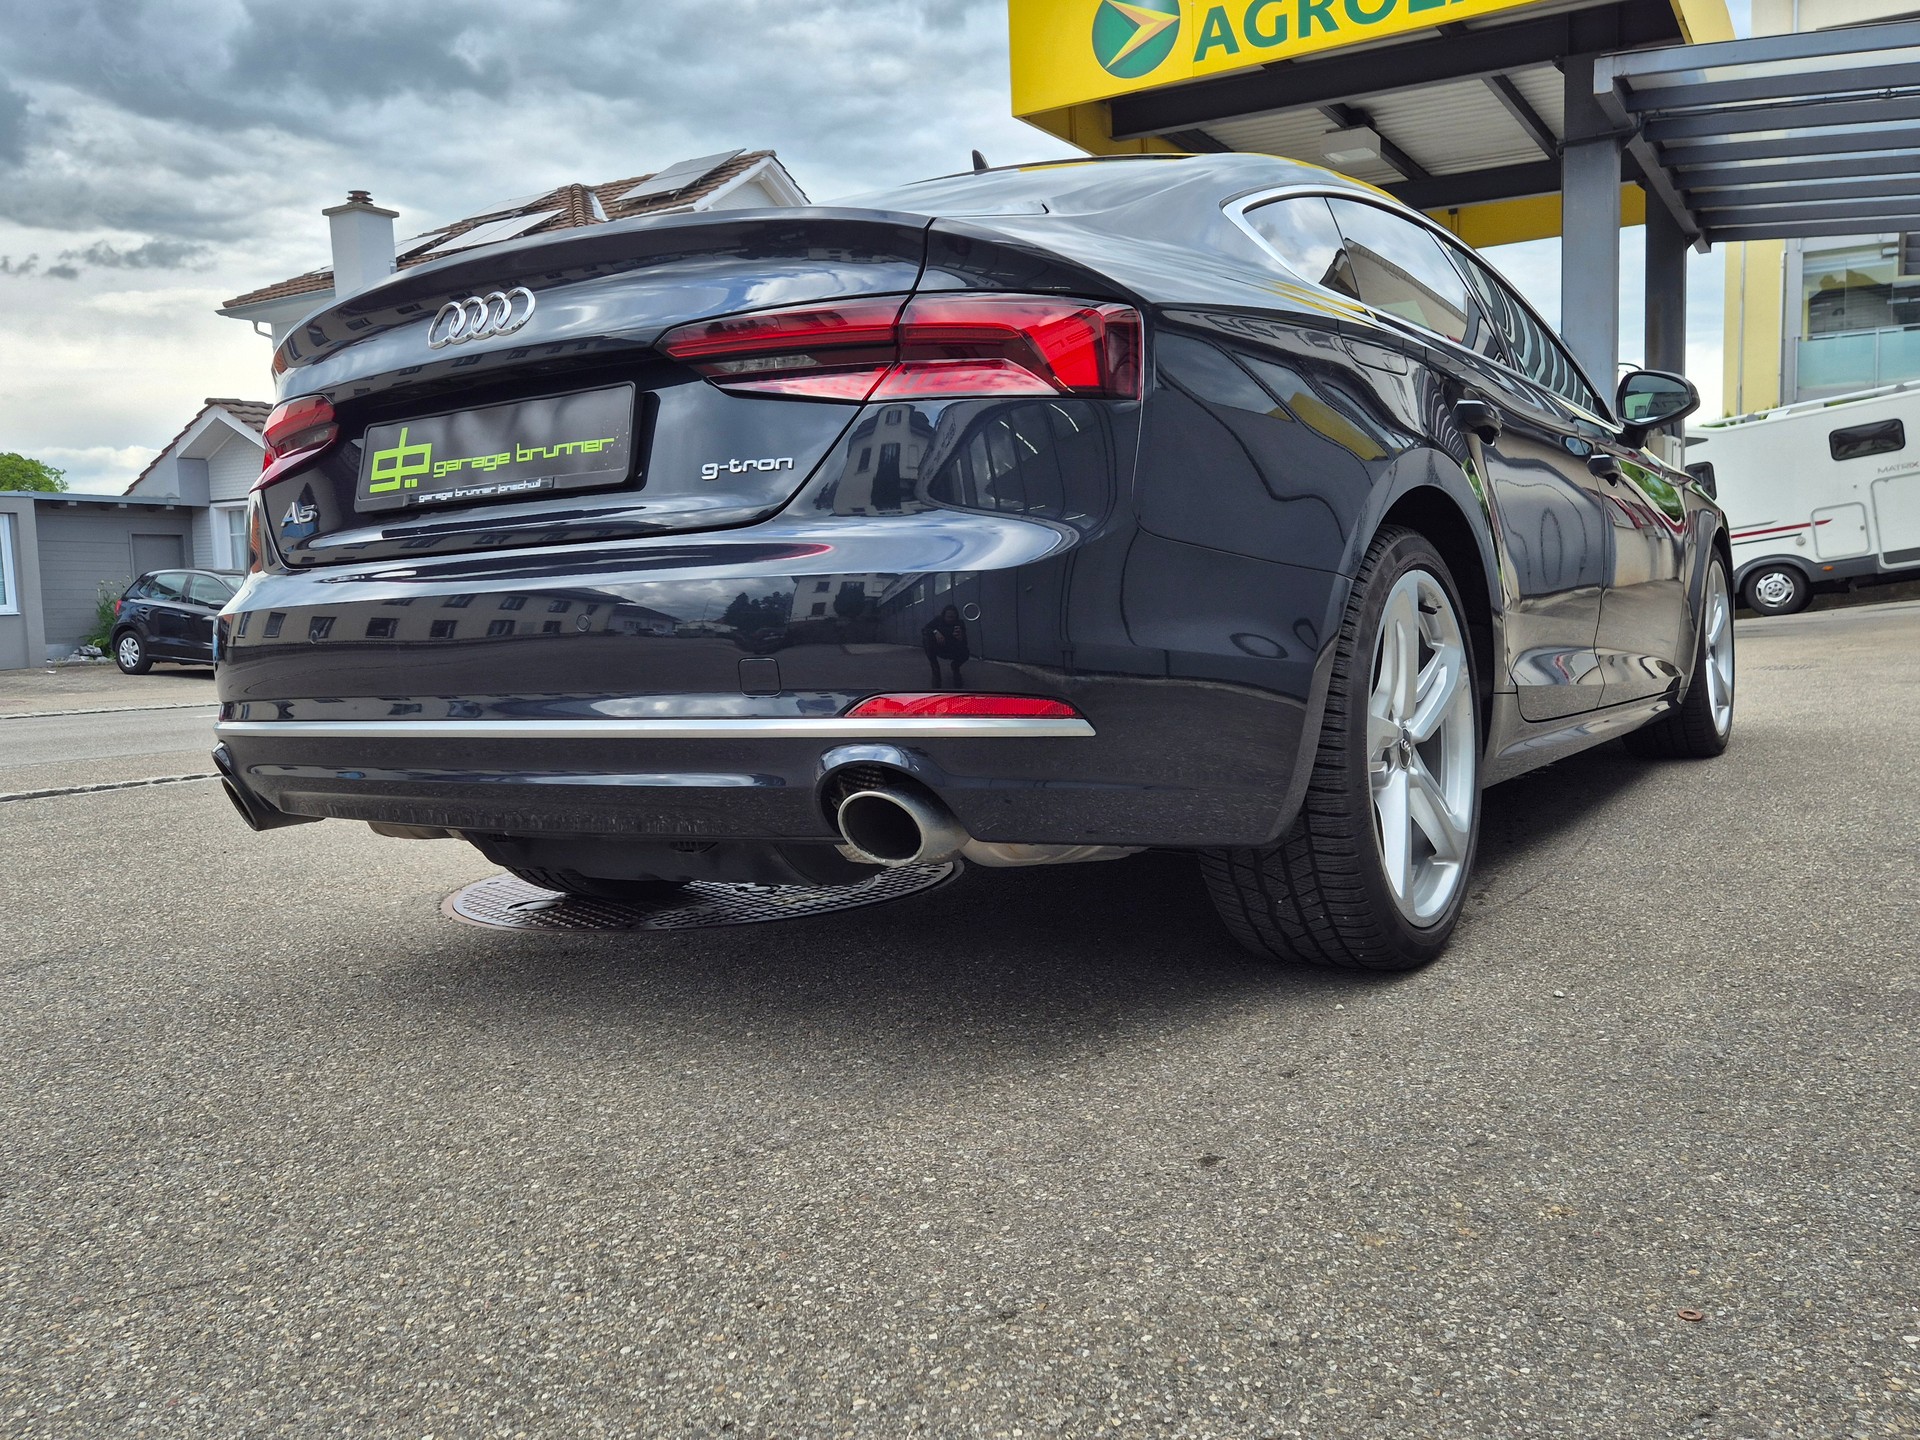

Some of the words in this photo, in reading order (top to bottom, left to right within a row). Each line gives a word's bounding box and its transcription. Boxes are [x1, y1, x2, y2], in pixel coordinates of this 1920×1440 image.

[432, 452, 510, 478] garage
[516, 437, 615, 462] brunner
[701, 457, 793, 480] g-tron
[1877, 461, 1919, 474] MATRIX
[418, 491, 453, 503] garage
[454, 488, 496, 497] brunner
[280, 501, 317, 527] A5
